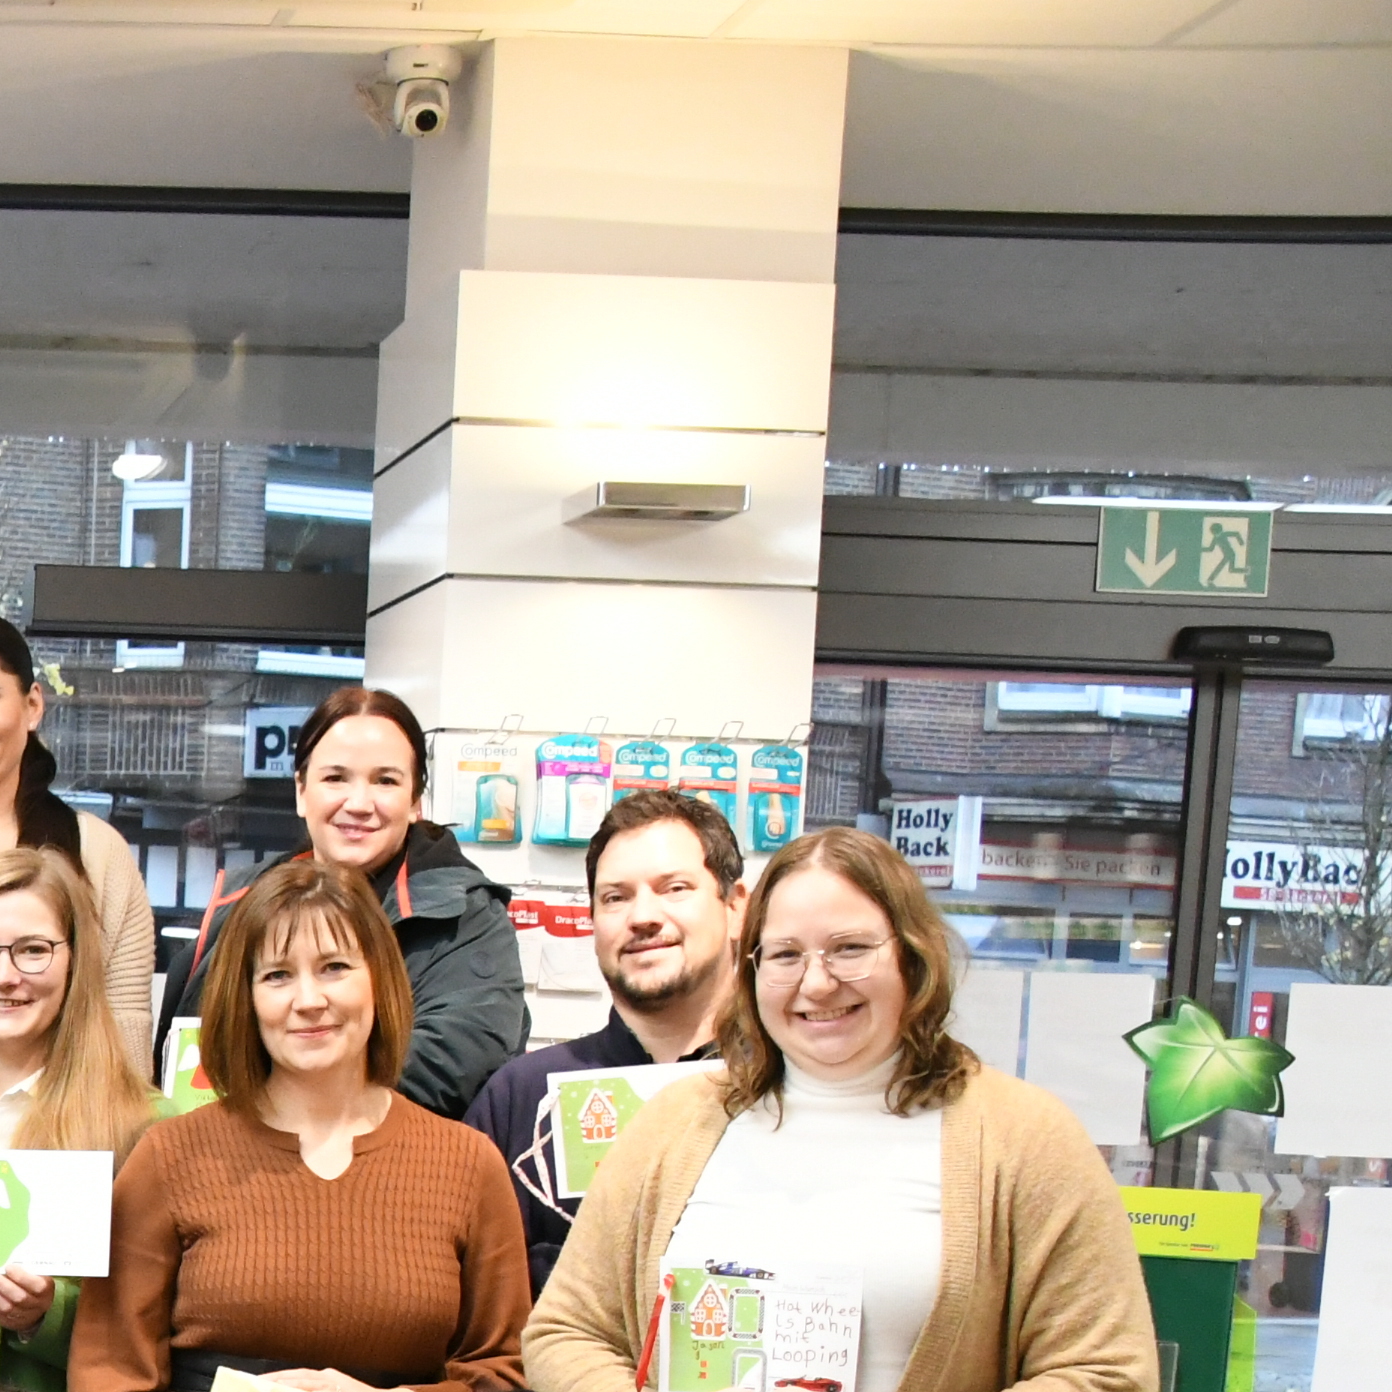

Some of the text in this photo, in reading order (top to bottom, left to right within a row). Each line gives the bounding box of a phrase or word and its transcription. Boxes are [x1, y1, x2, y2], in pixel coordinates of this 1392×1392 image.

[896, 808, 954, 831] Holly
[896, 836, 949, 858] Back
[1065, 857, 1089, 872] Sie
[775, 1331, 810, 1344] mit
[804, 1316, 853, 1339] Bahn
[772, 1345, 848, 1369] Looping
